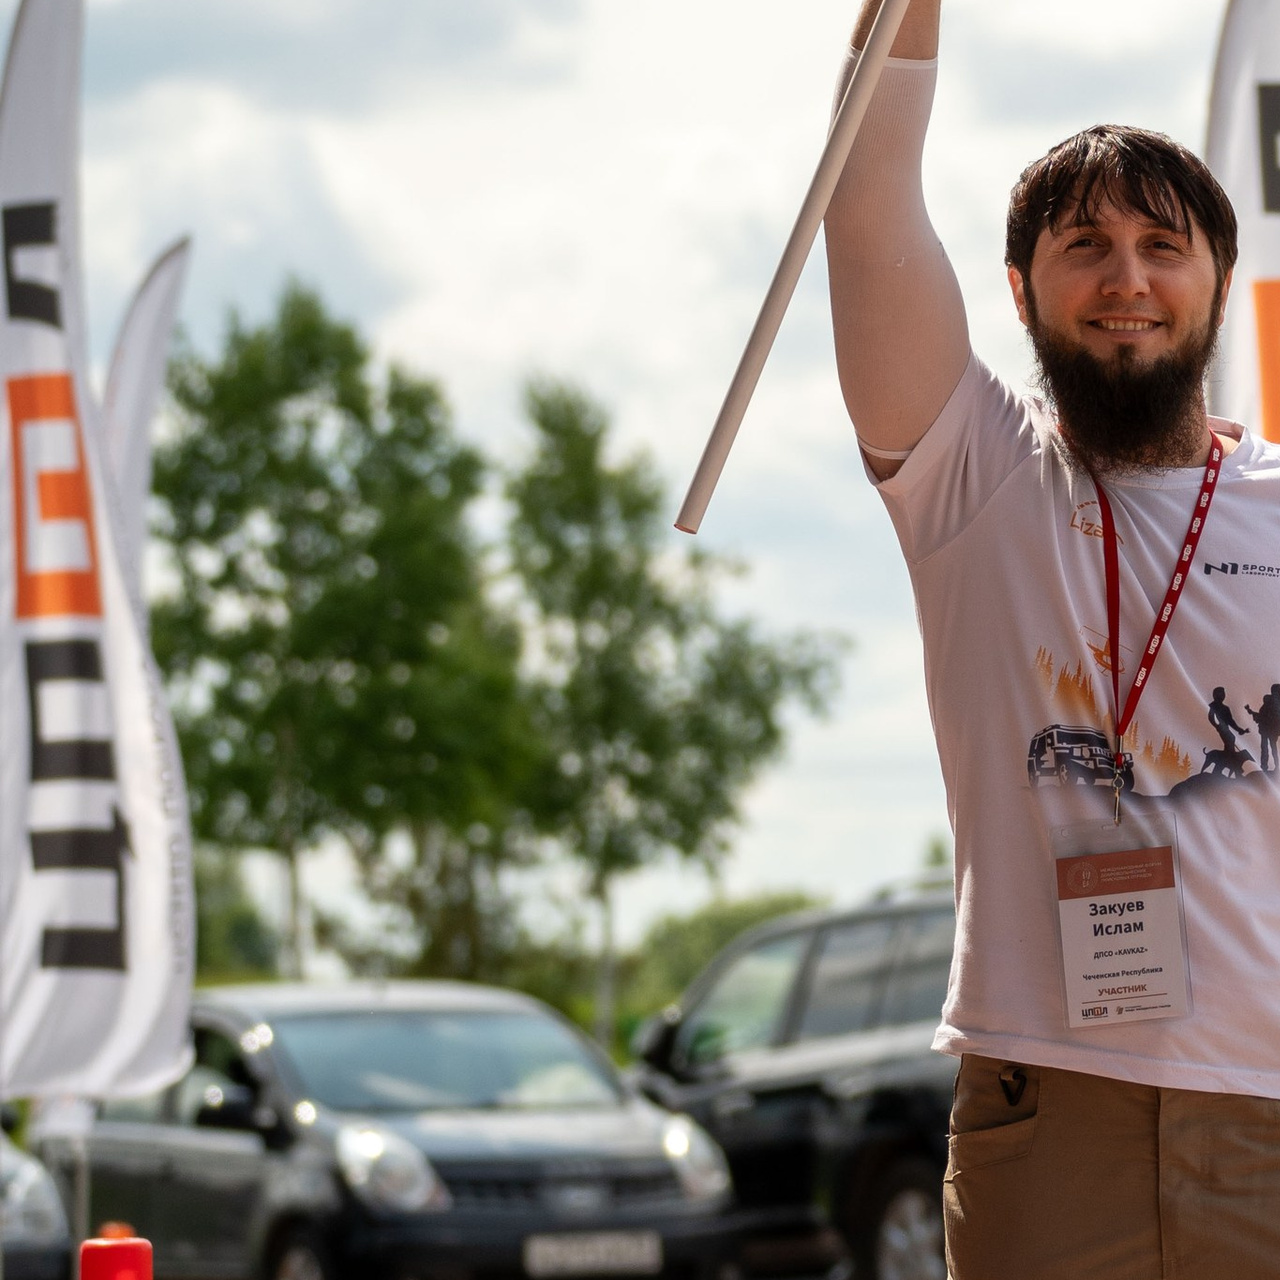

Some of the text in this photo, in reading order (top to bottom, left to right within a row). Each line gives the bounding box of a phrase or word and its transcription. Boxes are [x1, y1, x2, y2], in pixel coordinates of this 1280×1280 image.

[1089, 900, 1145, 917] Закуев
[1093, 921, 1144, 937] Ислам
[1093, 949, 1113, 960] ДПСО
[1082, 966, 1163, 981] Чеченская Республика
[1098, 984, 1147, 997] УЧАСТНИК
